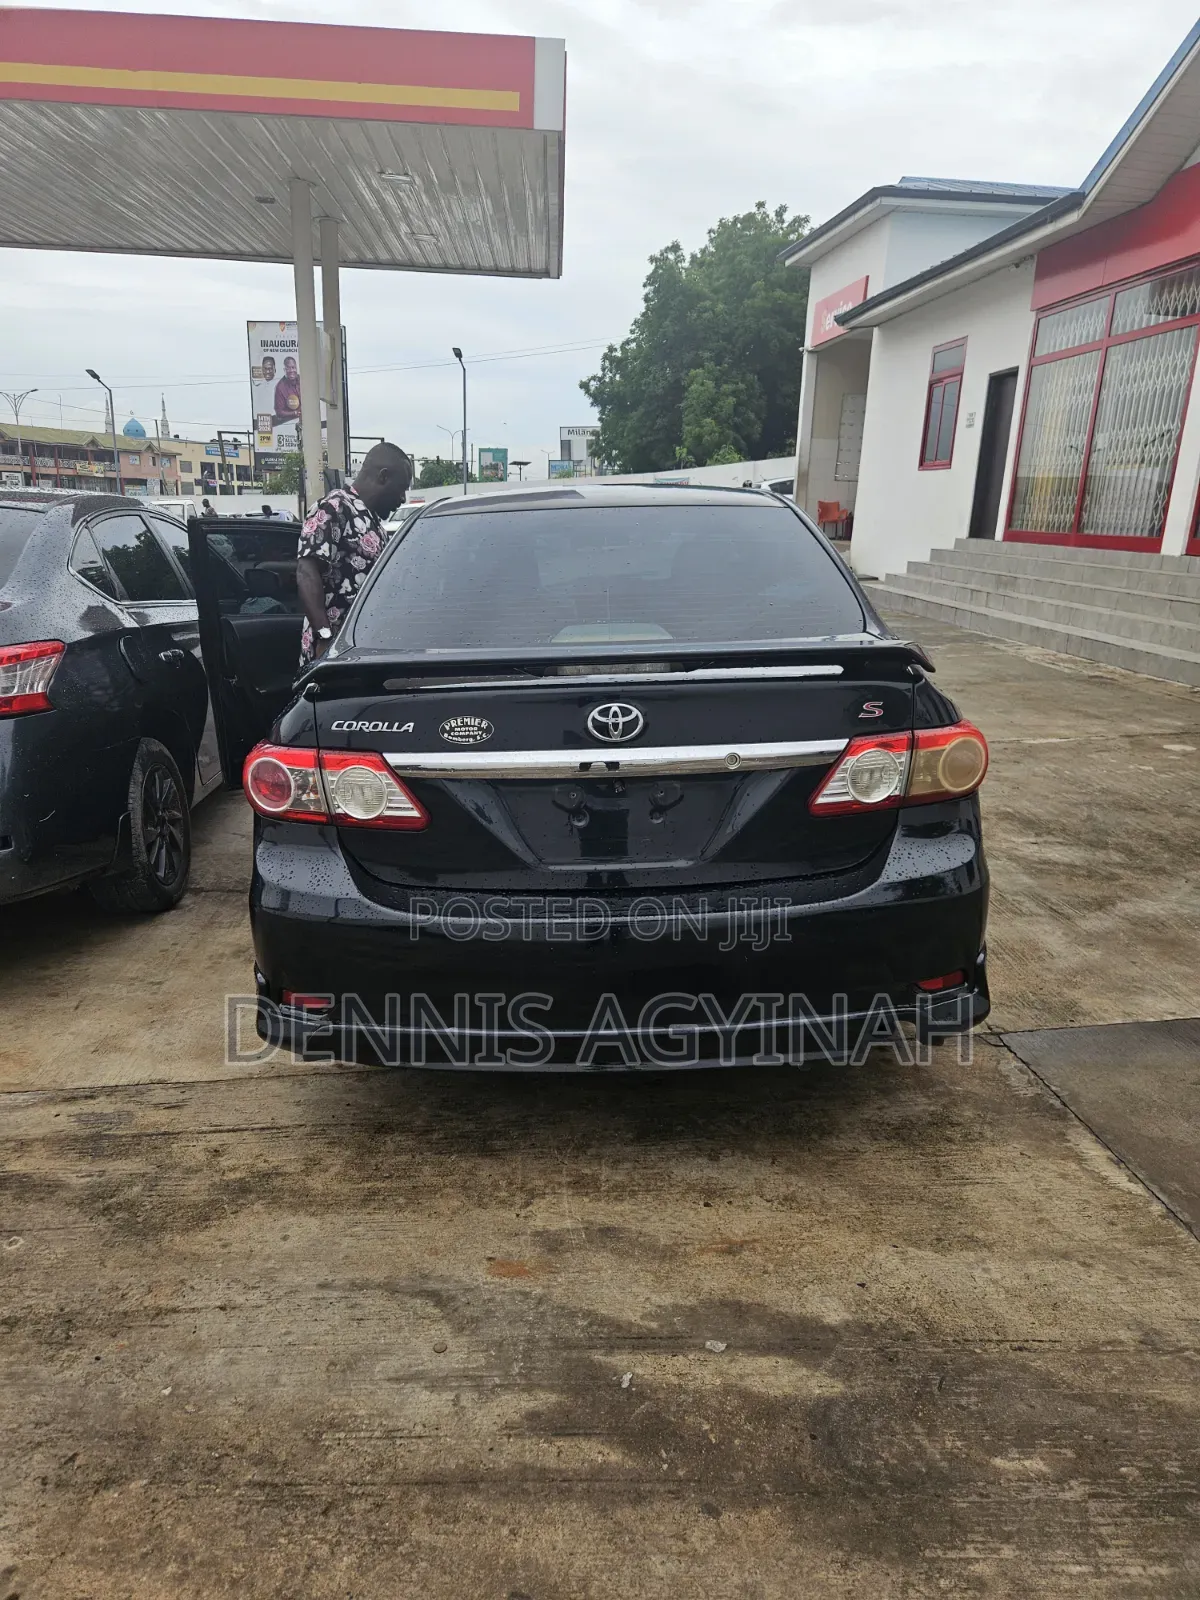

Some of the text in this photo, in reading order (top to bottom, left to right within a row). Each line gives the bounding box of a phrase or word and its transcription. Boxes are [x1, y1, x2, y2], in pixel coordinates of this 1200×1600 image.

[858, 701, 884, 718] S
[330, 720, 415, 733] COROLLA
[443, 717, 489, 731] PREMIER
